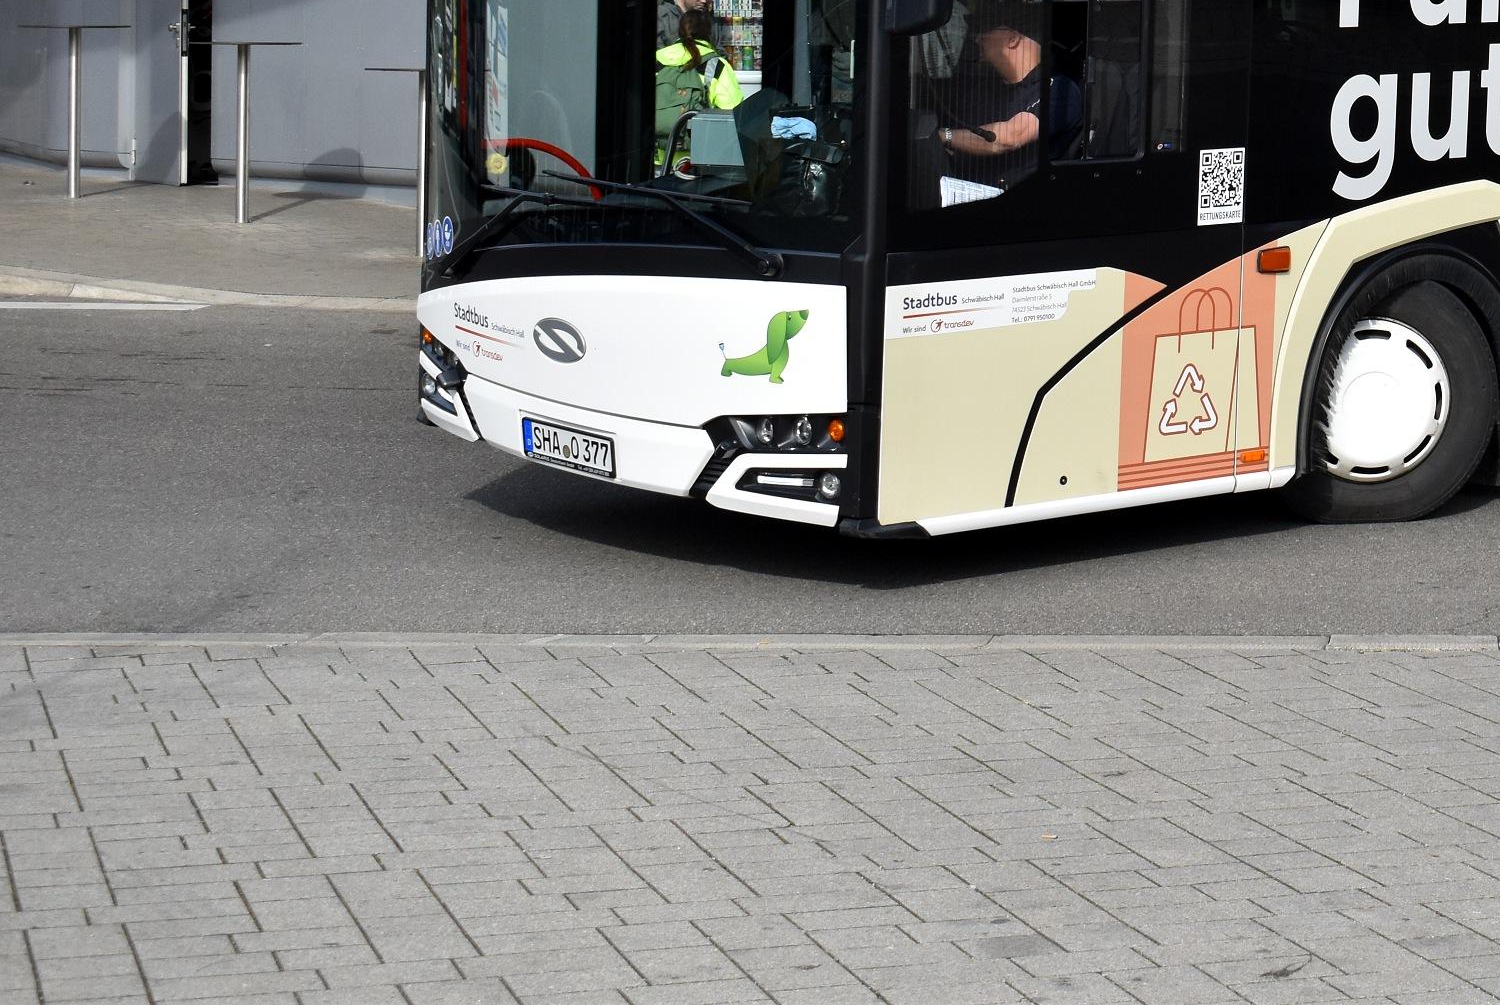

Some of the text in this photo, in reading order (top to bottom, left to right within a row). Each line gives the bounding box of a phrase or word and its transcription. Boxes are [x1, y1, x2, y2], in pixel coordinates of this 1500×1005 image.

[1199, 210, 1241, 221] RETTUNGSKARTE
[1012, 279, 1097, 294] Stadtbus Schwäbisch Hall GmbH
[903, 292, 1005, 310] Stadtbus Schwäbisch Hall
[1027, 302, 1057, 312] Schwäbisch
[454, 302, 489, 328] Stadtbus
[914, 324, 927, 332] sind
[944, 319, 975, 329] transdev
[533, 426, 561, 456] SHA
[582, 438, 609, 467] 377
